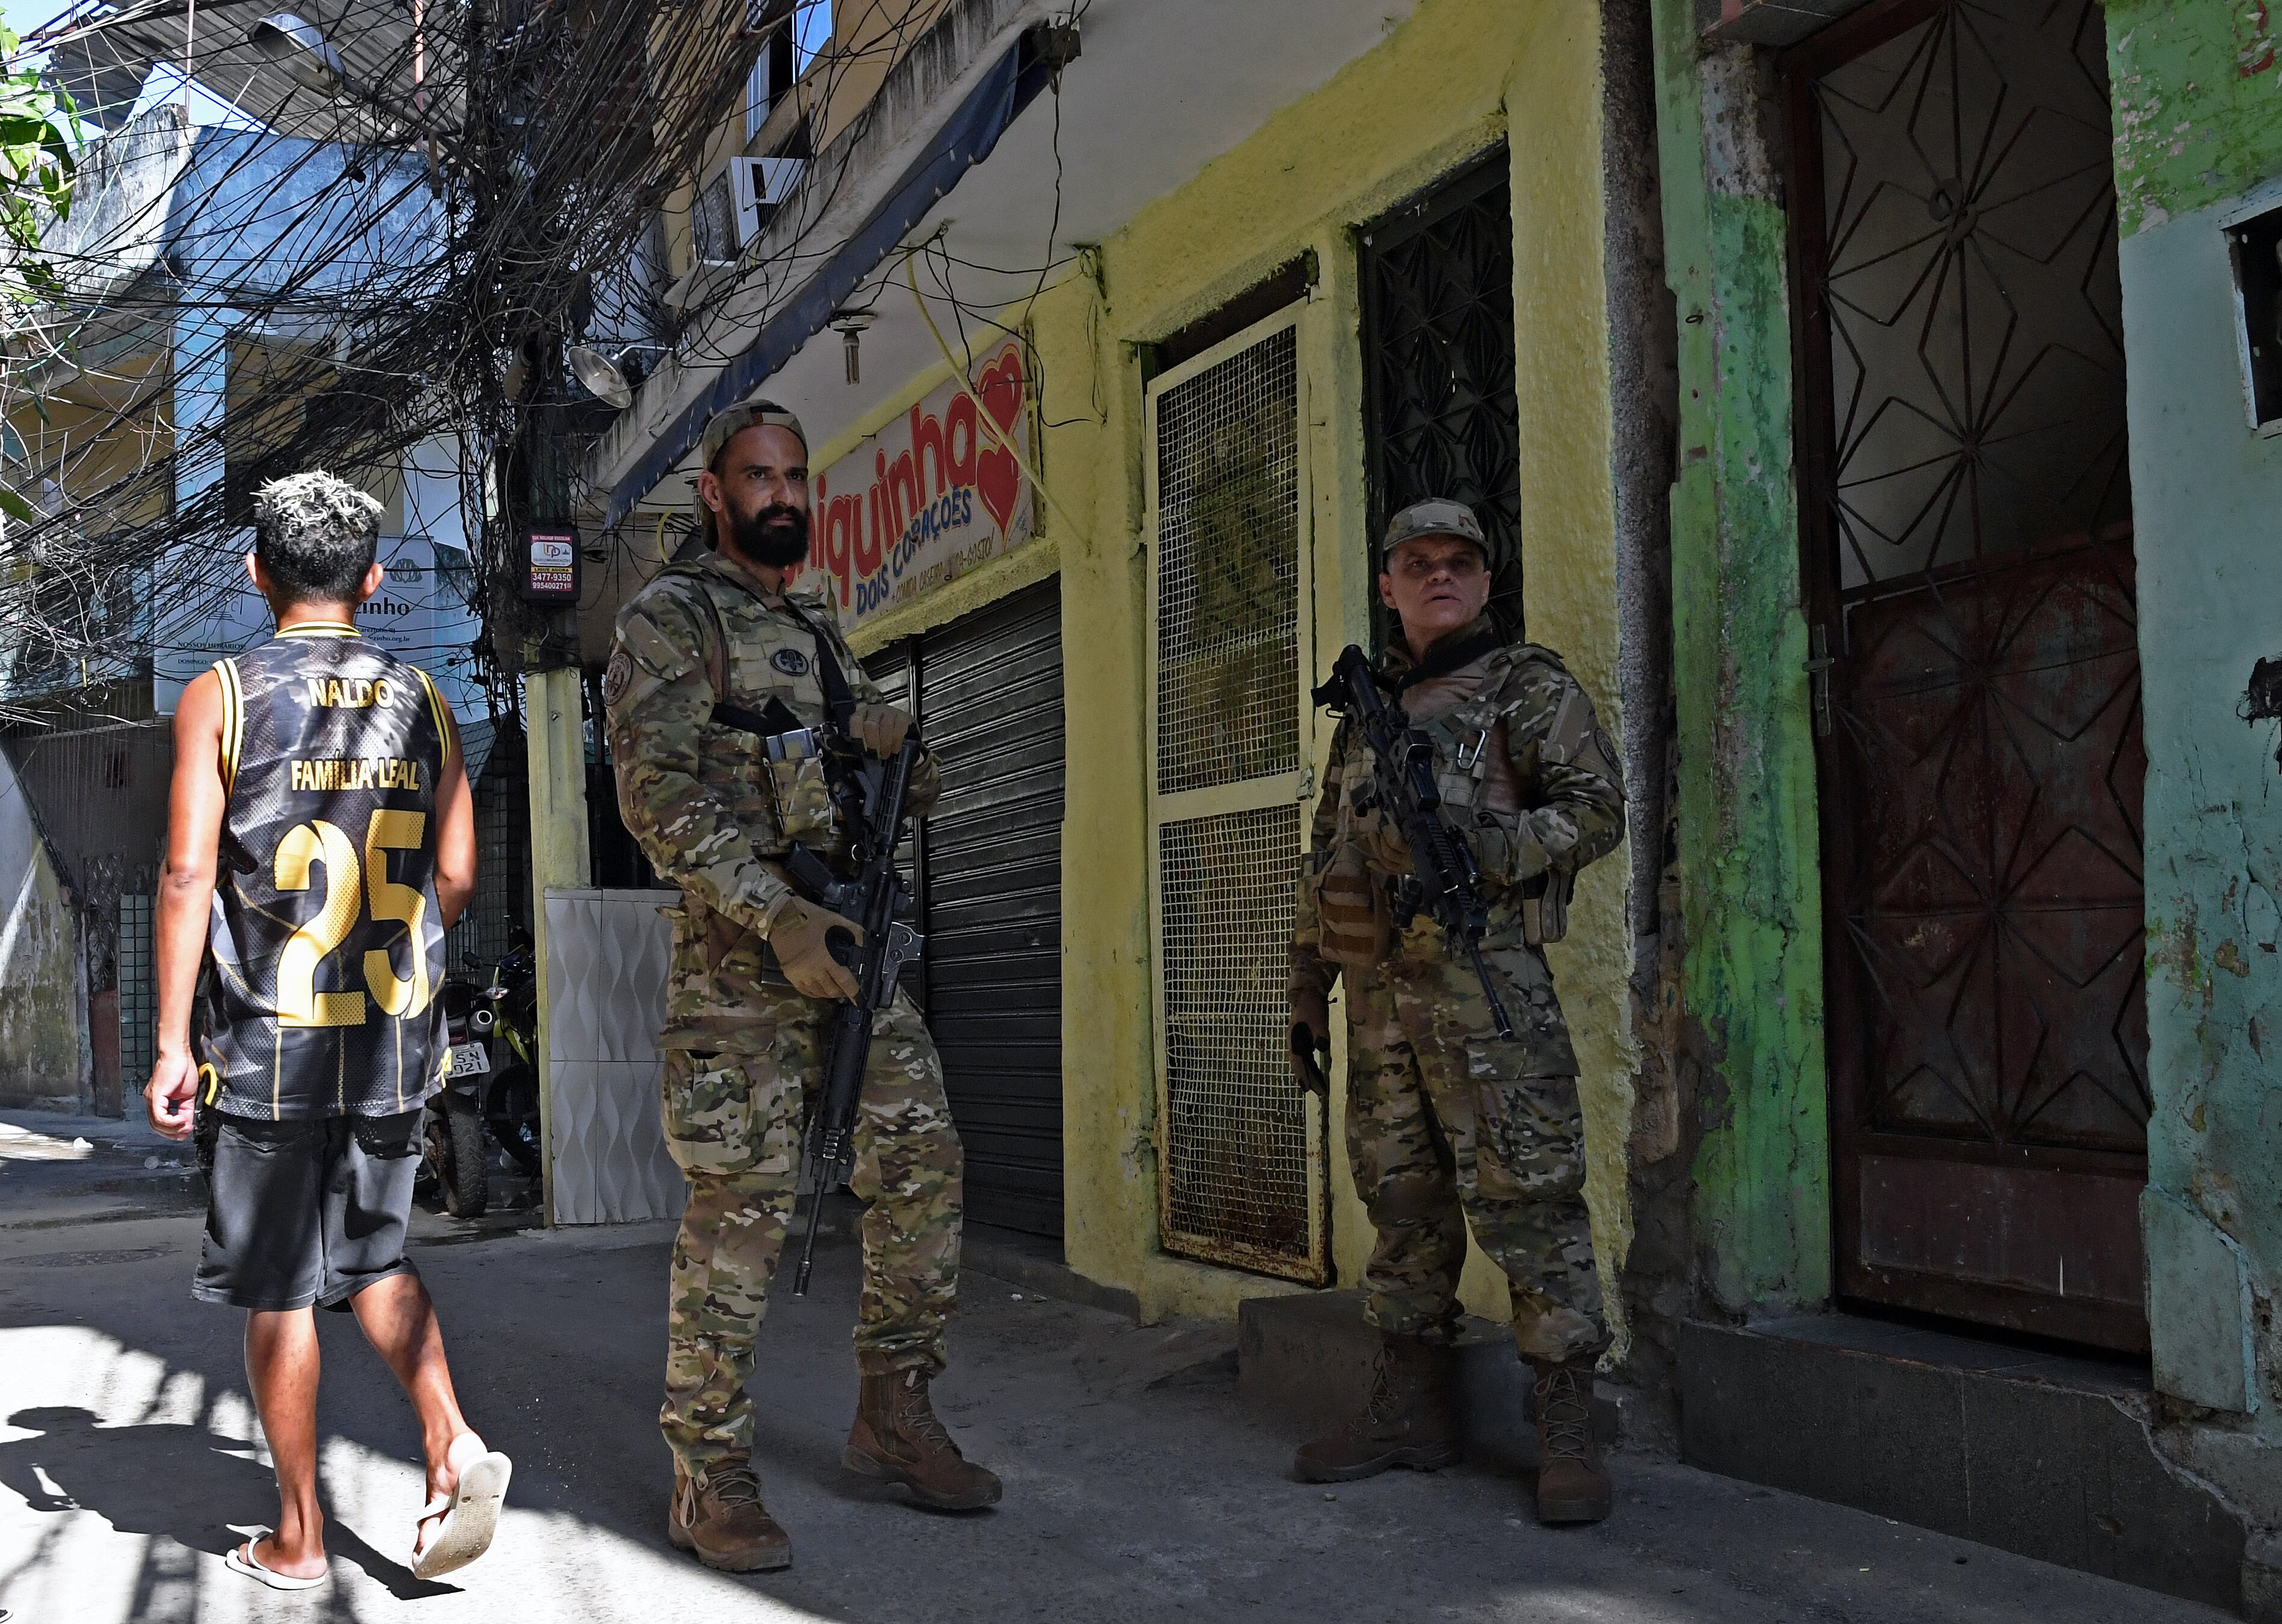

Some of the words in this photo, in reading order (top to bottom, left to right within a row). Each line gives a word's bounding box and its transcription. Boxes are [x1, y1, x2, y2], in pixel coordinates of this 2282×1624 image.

[783, 392, 977, 609] iquinha
[533, 573, 571, 581] 3477-9350
[857, 565, 888, 616] DOIS
[306, 678, 395, 709] NALDO
[291, 750, 374, 791] FAMÍLIA
[378, 759, 420, 790] LEAL
[274, 808, 430, 1027] 25
